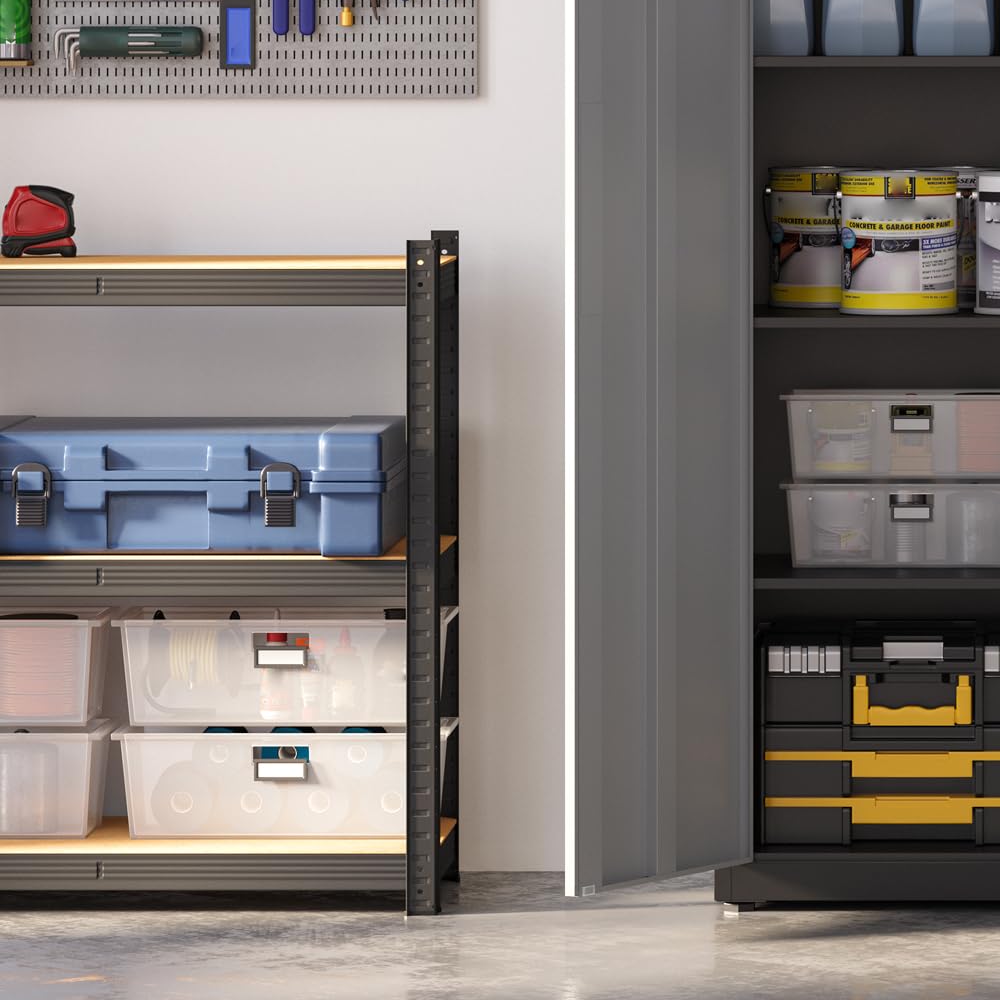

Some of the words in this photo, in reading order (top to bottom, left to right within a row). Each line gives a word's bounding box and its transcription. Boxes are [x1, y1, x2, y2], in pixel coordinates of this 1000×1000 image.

[849, 221, 876, 230] CONCRETE
[886, 223, 913, 231] GARAGE
[915, 222, 935, 231] FLOOR
